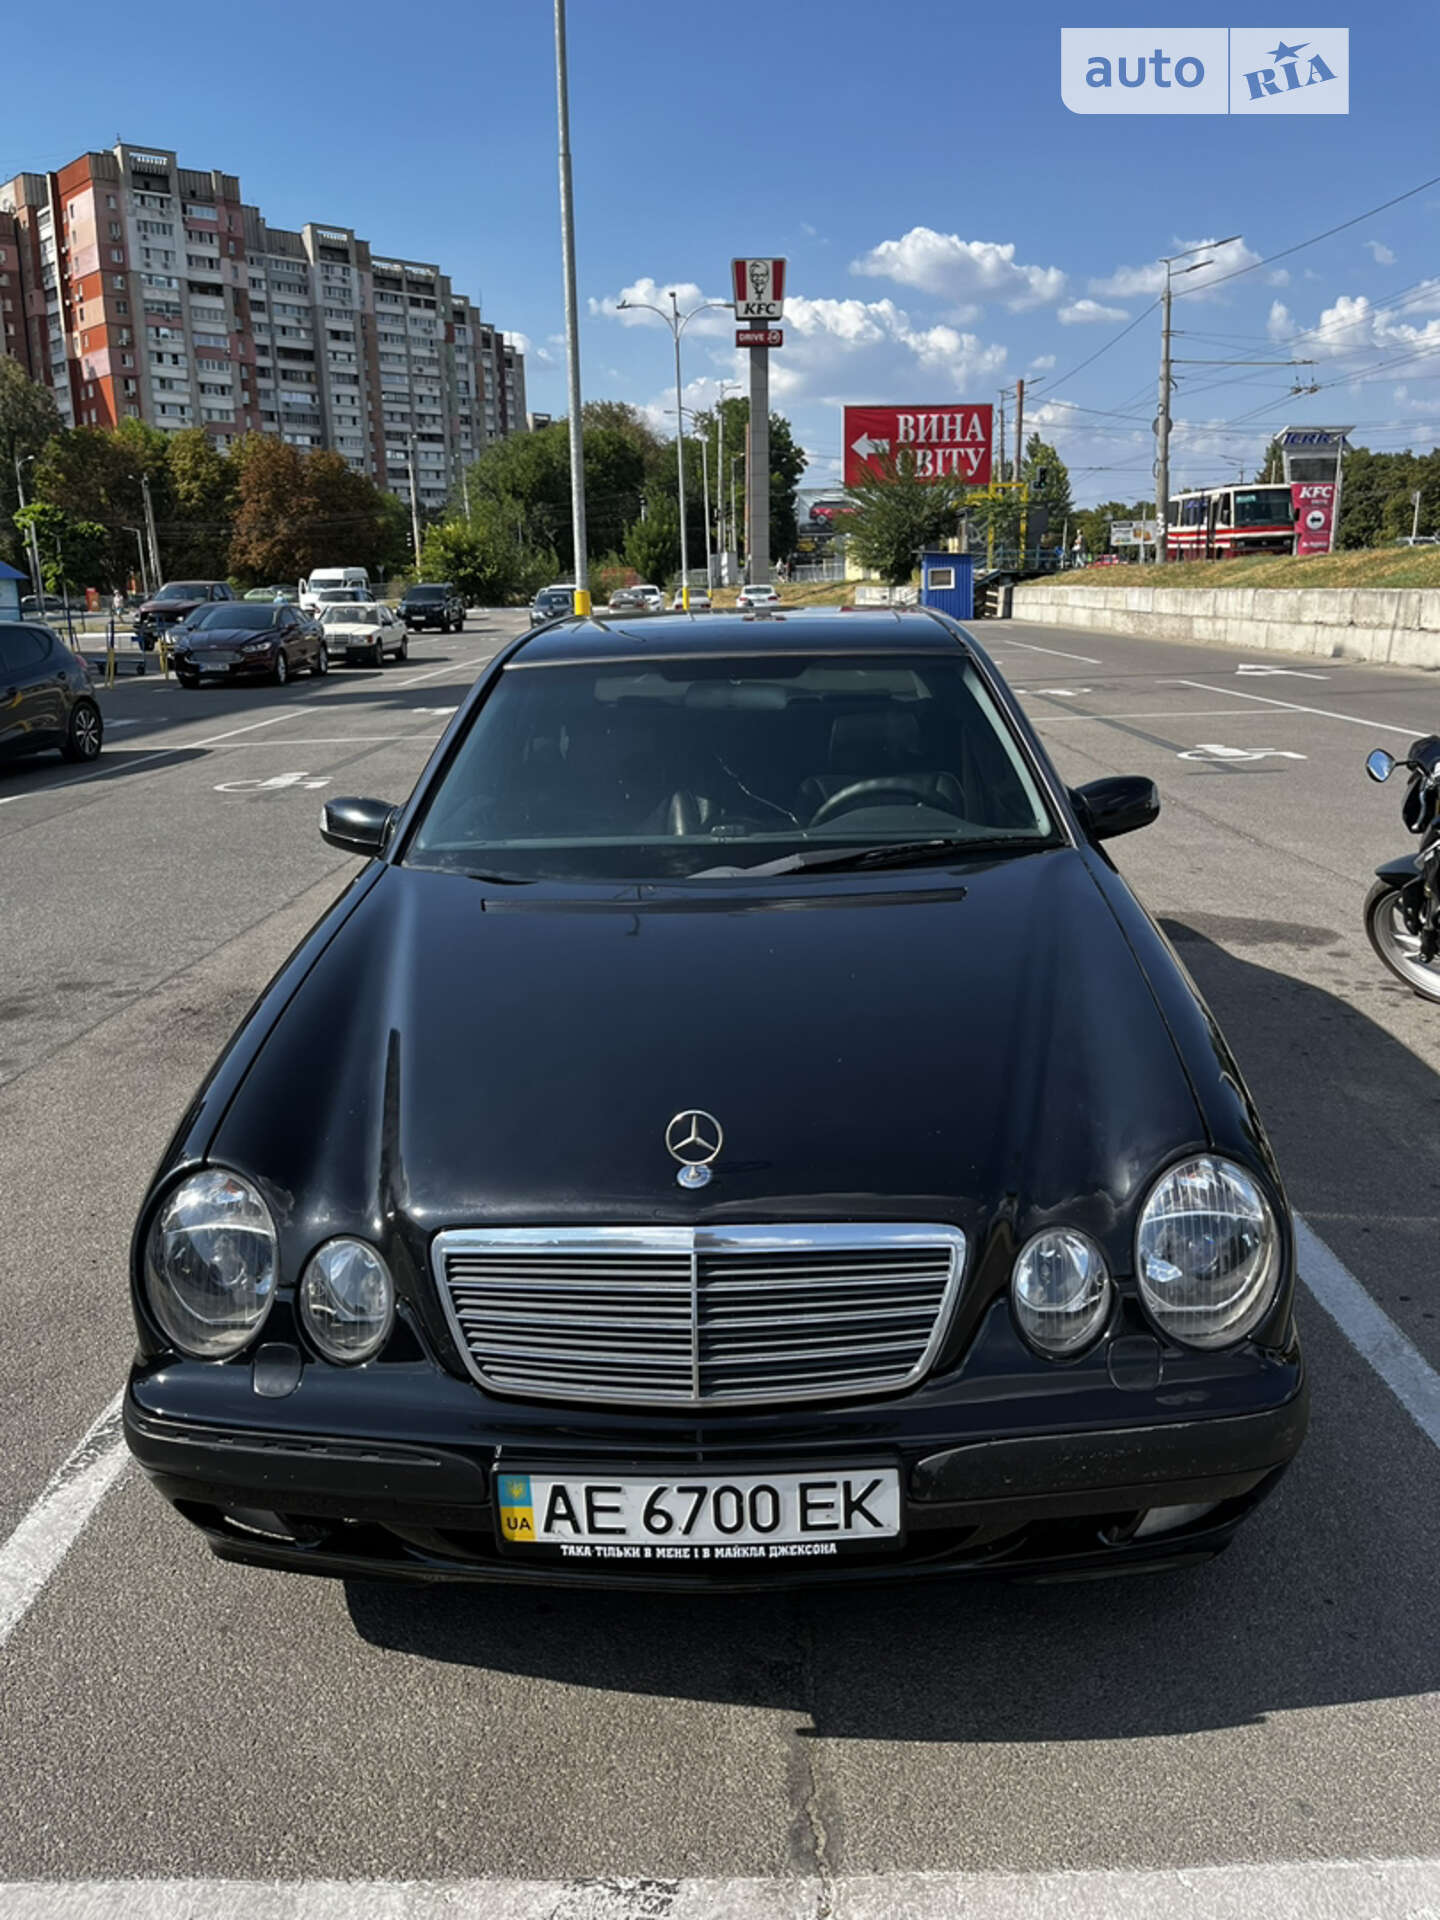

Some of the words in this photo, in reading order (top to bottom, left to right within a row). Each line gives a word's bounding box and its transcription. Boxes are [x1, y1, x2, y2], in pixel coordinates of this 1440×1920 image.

[744, 302, 776, 316] KFC
[896, 413, 985, 443] ВИНА
[1300, 486, 1332, 498] KFC
[506, 1517, 532, 1531] UA
[543, 1484, 627, 1535] AE
[642, 1485, 781, 1535] 6700
[799, 1479, 883, 1532] EK
[560, 1545, 592, 1557] ТАКА
[595, 1546, 640, 1558] ТІЛЬКИ
[643, 1547, 652, 1558] В
[656, 1547, 690, 1558] МЕНЕ
[702, 1547, 711, 1558] В
[714, 1545, 766, 1558] МАЙКЛА
[769, 1542, 837, 1558] ДЖЕКСОНА
